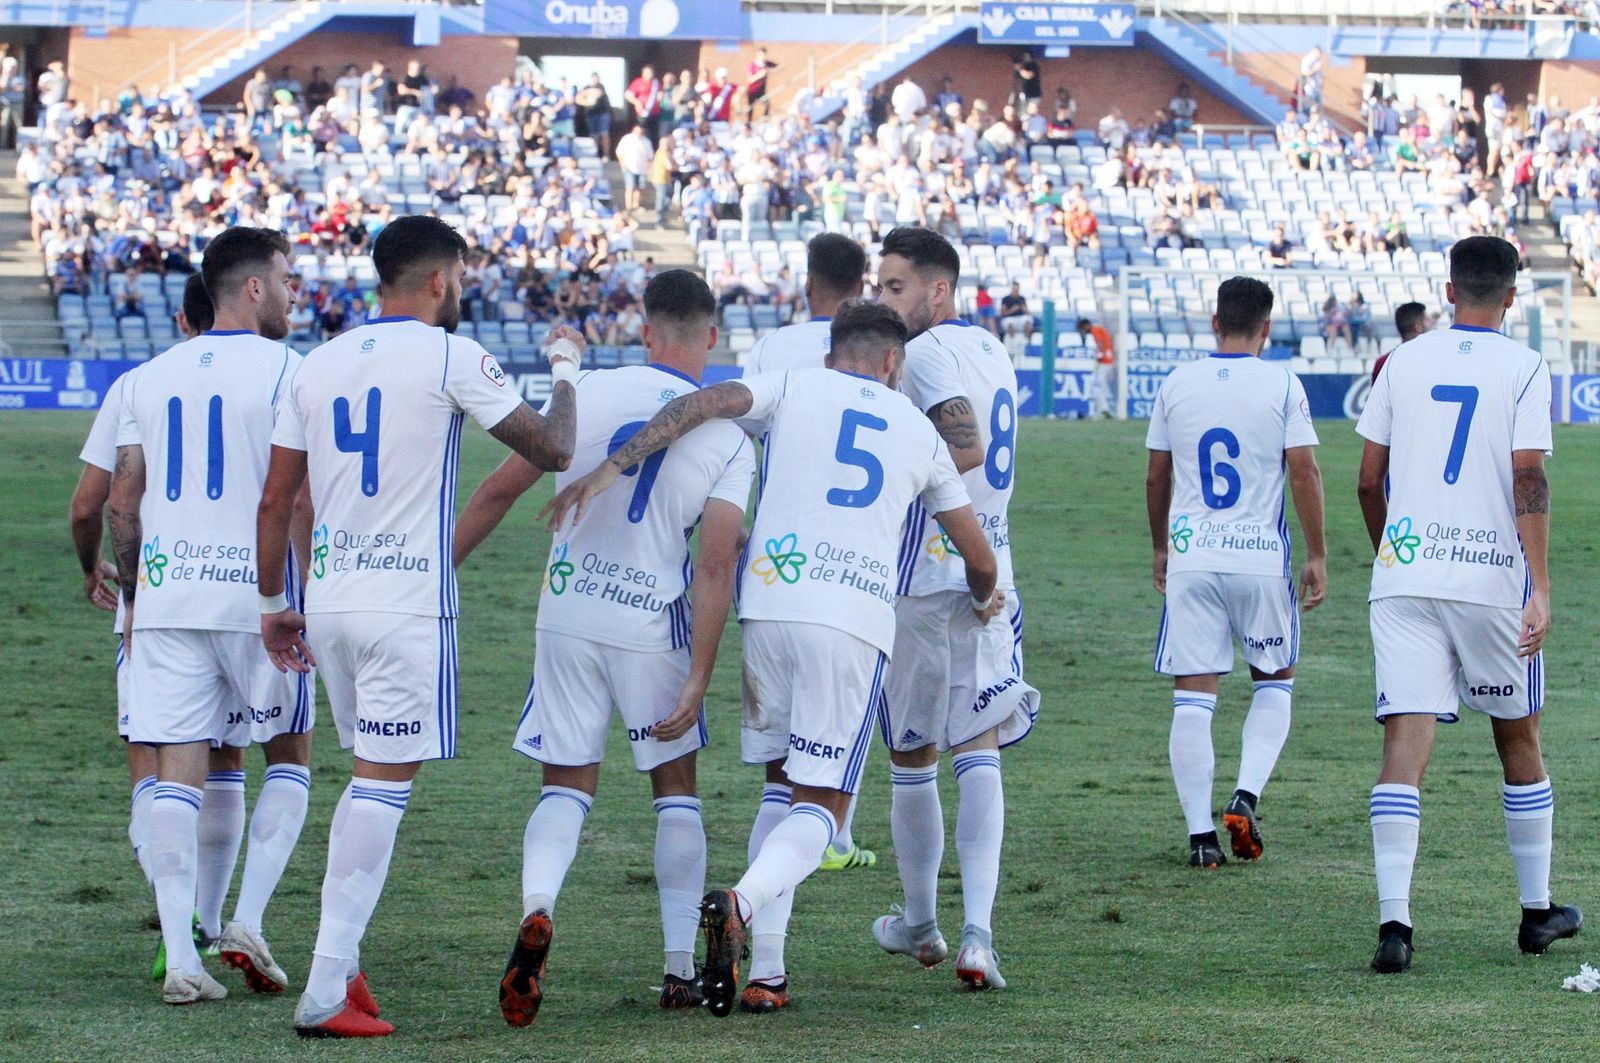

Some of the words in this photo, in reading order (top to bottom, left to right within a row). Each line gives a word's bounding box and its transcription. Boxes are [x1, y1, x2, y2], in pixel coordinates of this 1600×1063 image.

[545, 0, 629, 24] Onuba
[333, 386, 382, 498] 4
[984, 387, 1015, 491] 8
[1430, 384, 1480, 485] 7
[166, 394, 224, 502] 11
[826, 408, 888, 509] 5
[607, 420, 669, 524] 9
[1198, 427, 1241, 510] 6
[1200, 520, 1229, 534] Que
[1234, 522, 1261, 535] sea
[1426, 522, 1461, 542] Que
[1465, 528, 1498, 545] sea
[174, 539, 212, 561] Que
[216, 544, 250, 562] sea
[333, 529, 371, 552] Que
[373, 533, 407, 548] sea
[333, 553, 352, 572] de
[814, 541, 856, 565] Que
[859, 555, 890, 580] sea
[1423, 543, 1446, 561] de
[1450, 545, 1514, 569] Huelva
[171, 562, 195, 581] de
[200, 564, 258, 585] Huelv
[582, 552, 620, 575] Que
[622, 567, 658, 589] sea
[809, 563, 835, 582] de
[574, 575, 598, 596] de
[357, 716, 421, 737] OMERO
